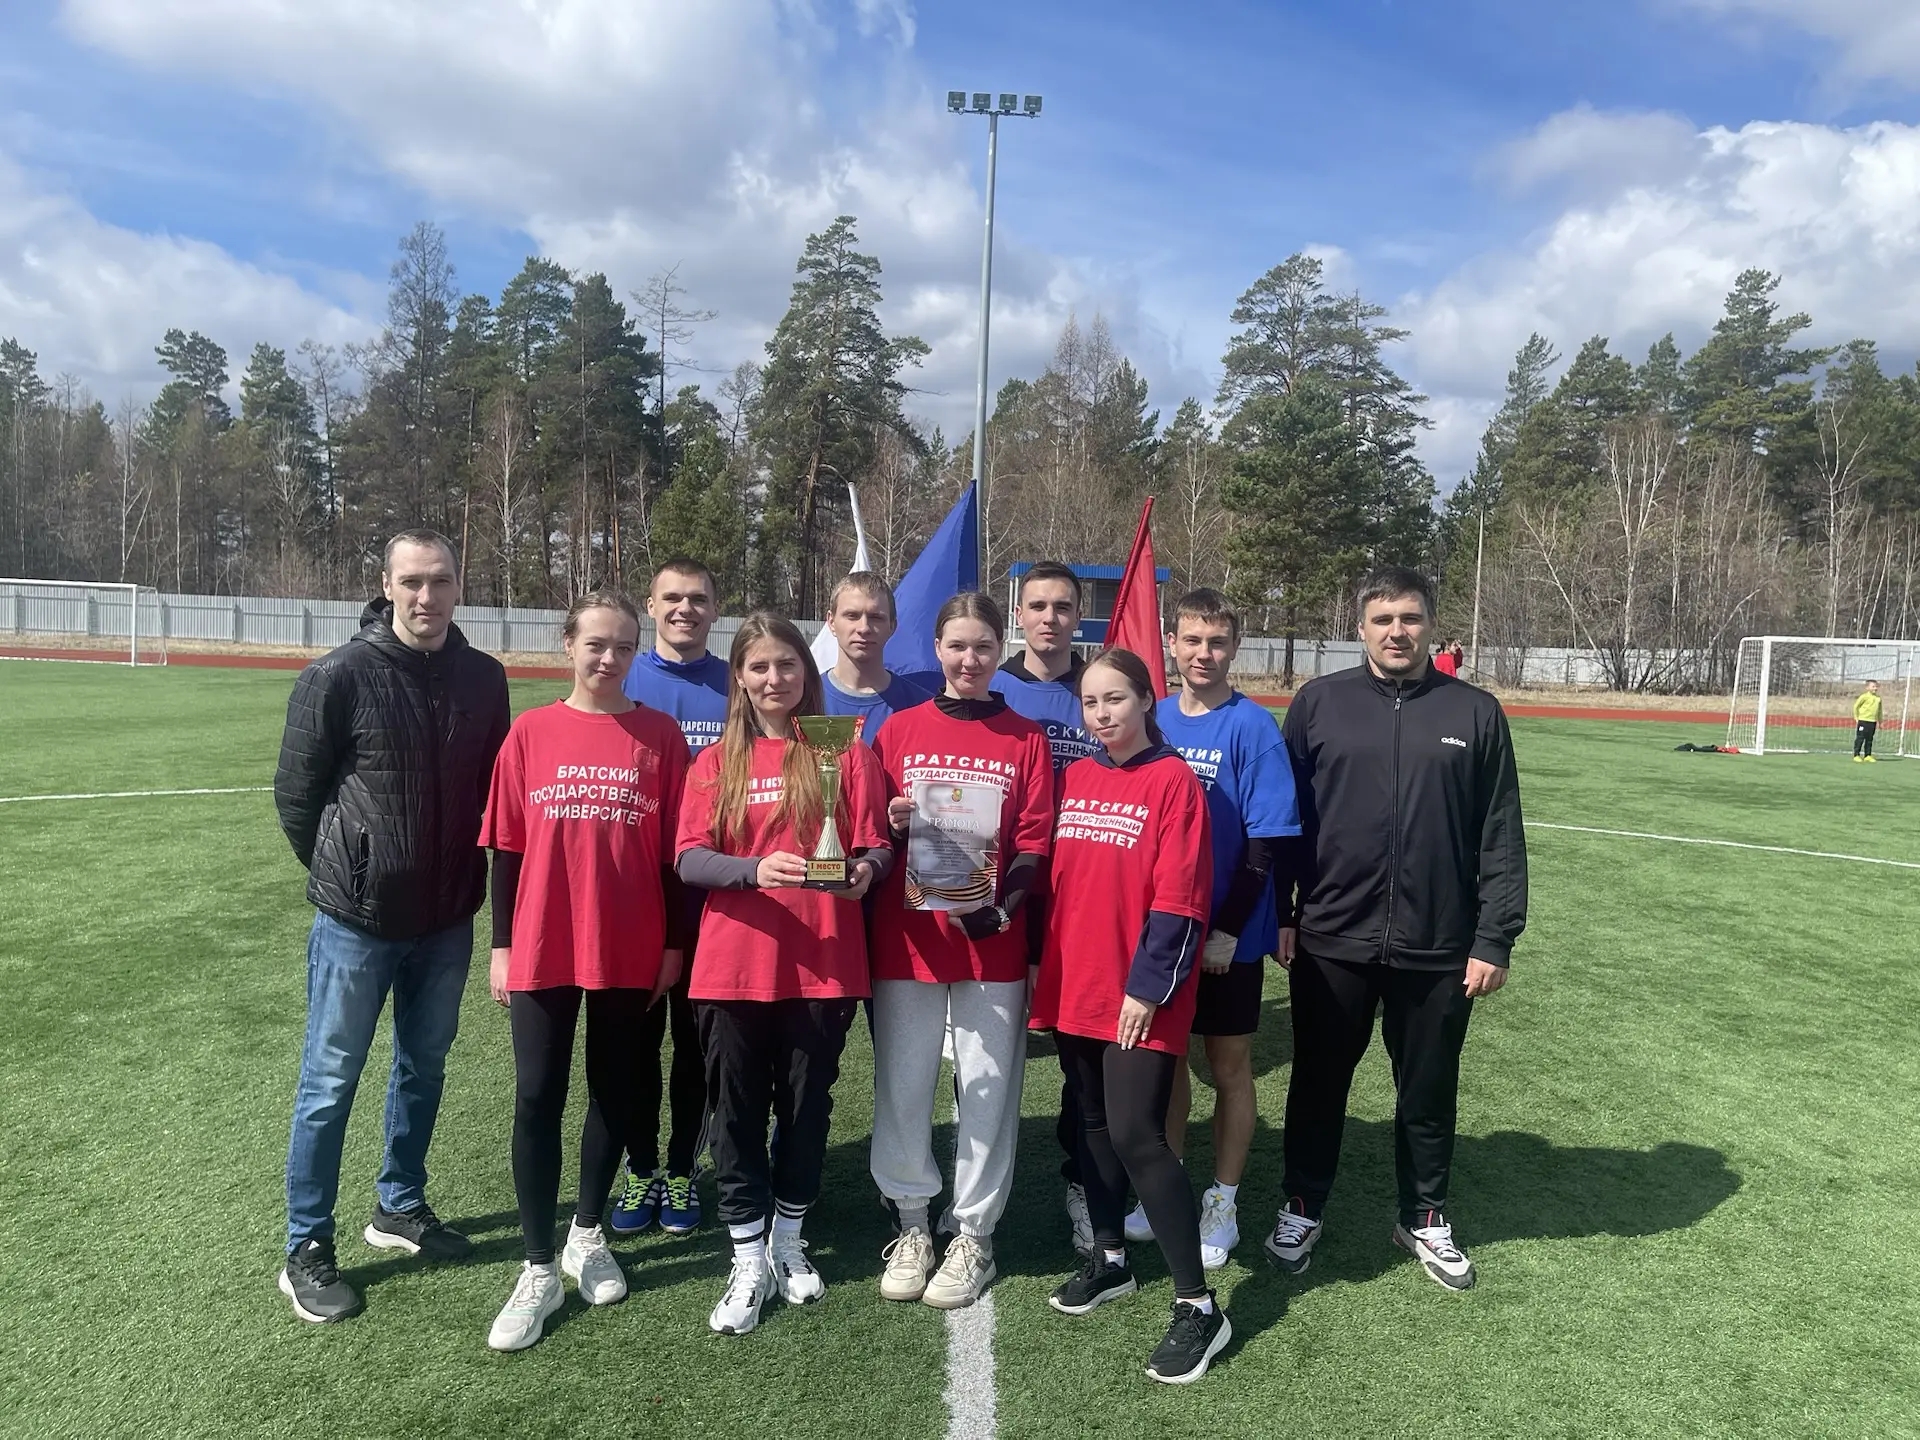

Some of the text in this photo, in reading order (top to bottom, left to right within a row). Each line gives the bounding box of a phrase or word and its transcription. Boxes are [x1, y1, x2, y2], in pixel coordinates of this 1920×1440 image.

[677, 719, 726, 732] ДАРСТВЕН
[1441, 737, 1467, 748] adidas
[903, 753, 1016, 777] БРАТСКИЙ
[1176, 747, 1223, 763] СКИЙ
[556, 765, 639, 785] БРАТСКИЙ
[903, 769, 1011, 789] ГОСУДАРСТВЕННЫЙ
[529, 783, 660, 815] ГОСУДАРСТВЕННЫЙ
[543, 804, 646, 827] УНИВЕРСИТЕТ
[928, 817, 980, 830] ГРАМОТА
[1059, 813, 1142, 834] СУДАРСТВЕННЫЙ
[1053, 826, 1138, 850] ИВЕРСИТЕТ
